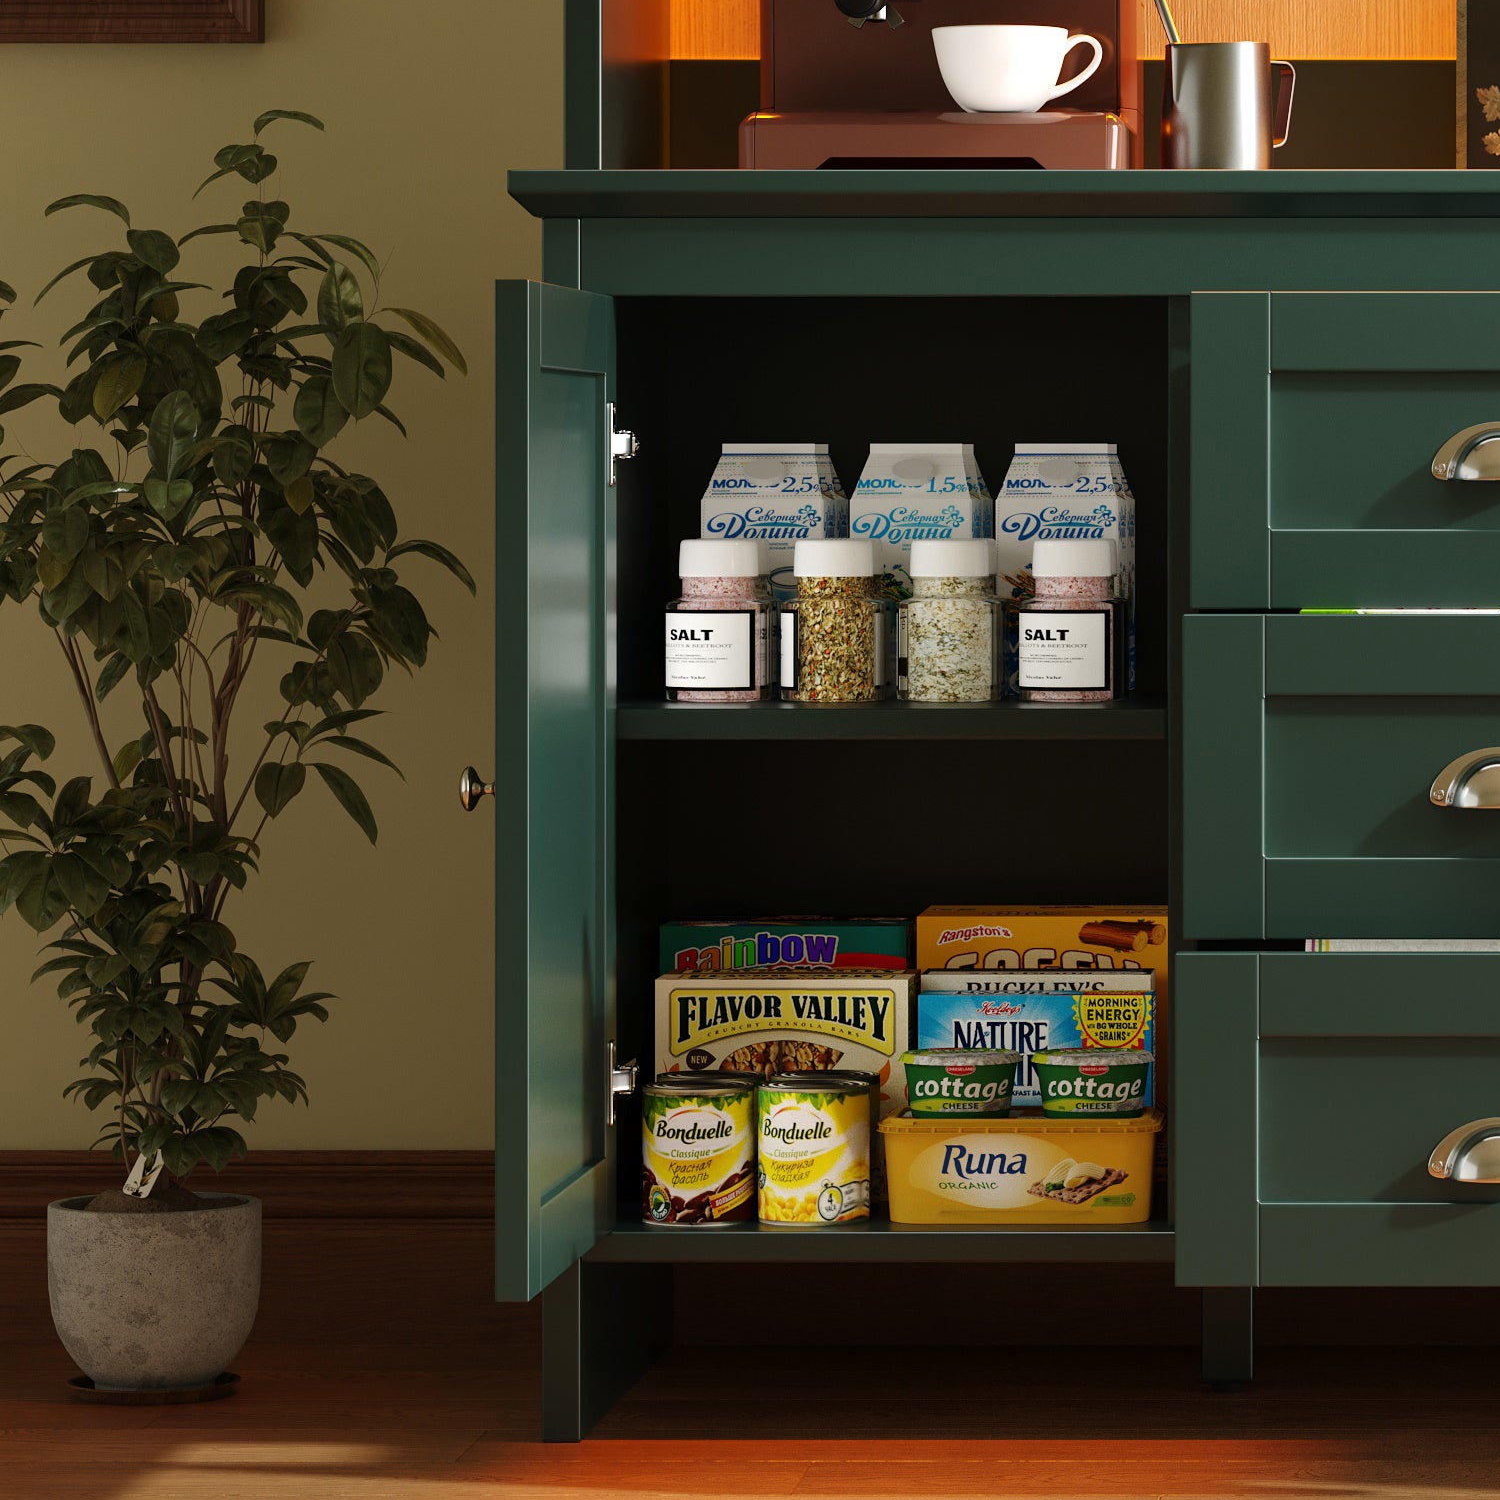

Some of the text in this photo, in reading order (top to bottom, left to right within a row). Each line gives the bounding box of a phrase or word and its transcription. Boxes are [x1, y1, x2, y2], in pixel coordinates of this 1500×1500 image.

[744, 506, 802, 524] Северная
[889, 506, 945, 524] Северная
[1039, 506, 1097, 524] Северная
[706, 512, 810, 539] Долина
[851, 512, 953, 545] Долина
[1001, 512, 1105, 541] Долина
[670, 628, 714, 641] SALT
[1025, 628, 1070, 641] SALT
[938, 925, 1012, 944] Rangston's
[675, 931, 838, 970] Rainbow
[1088, 998, 1138, 1007] MORNING
[677, 995, 890, 1044] FLAVOR VALLEY
[1087, 1009, 1140, 1021] ENERGY
[707, 1020, 861, 1038] CRUNCHY GRANOLA BARS
[953, 1021, 1048, 1052] NATURE
[1099, 1031, 1127, 1041] GRAINS
[690, 1054, 708, 1064] NEW
[914, 1077, 1009, 1103] cottage
[1047, 1076, 1142, 1103] cottage
[942, 1102, 980, 1110] CHEESE
[1075, 1102, 1112, 1110] CHEESE
[656, 1119, 733, 1145] Bonduelle
[763, 1118, 832, 1145] Bonduelle
[670, 1149, 711, 1159] Classique
[773, 1149, 809, 1160] Classique
[941, 1144, 1027, 1179] Runa
[668, 1160, 713, 1175] Красная
[770, 1159, 815, 1175] Кукуруза
[671, 1172, 710, 1188] фасоль
[938, 1181, 1000, 1190] ORGANIC
